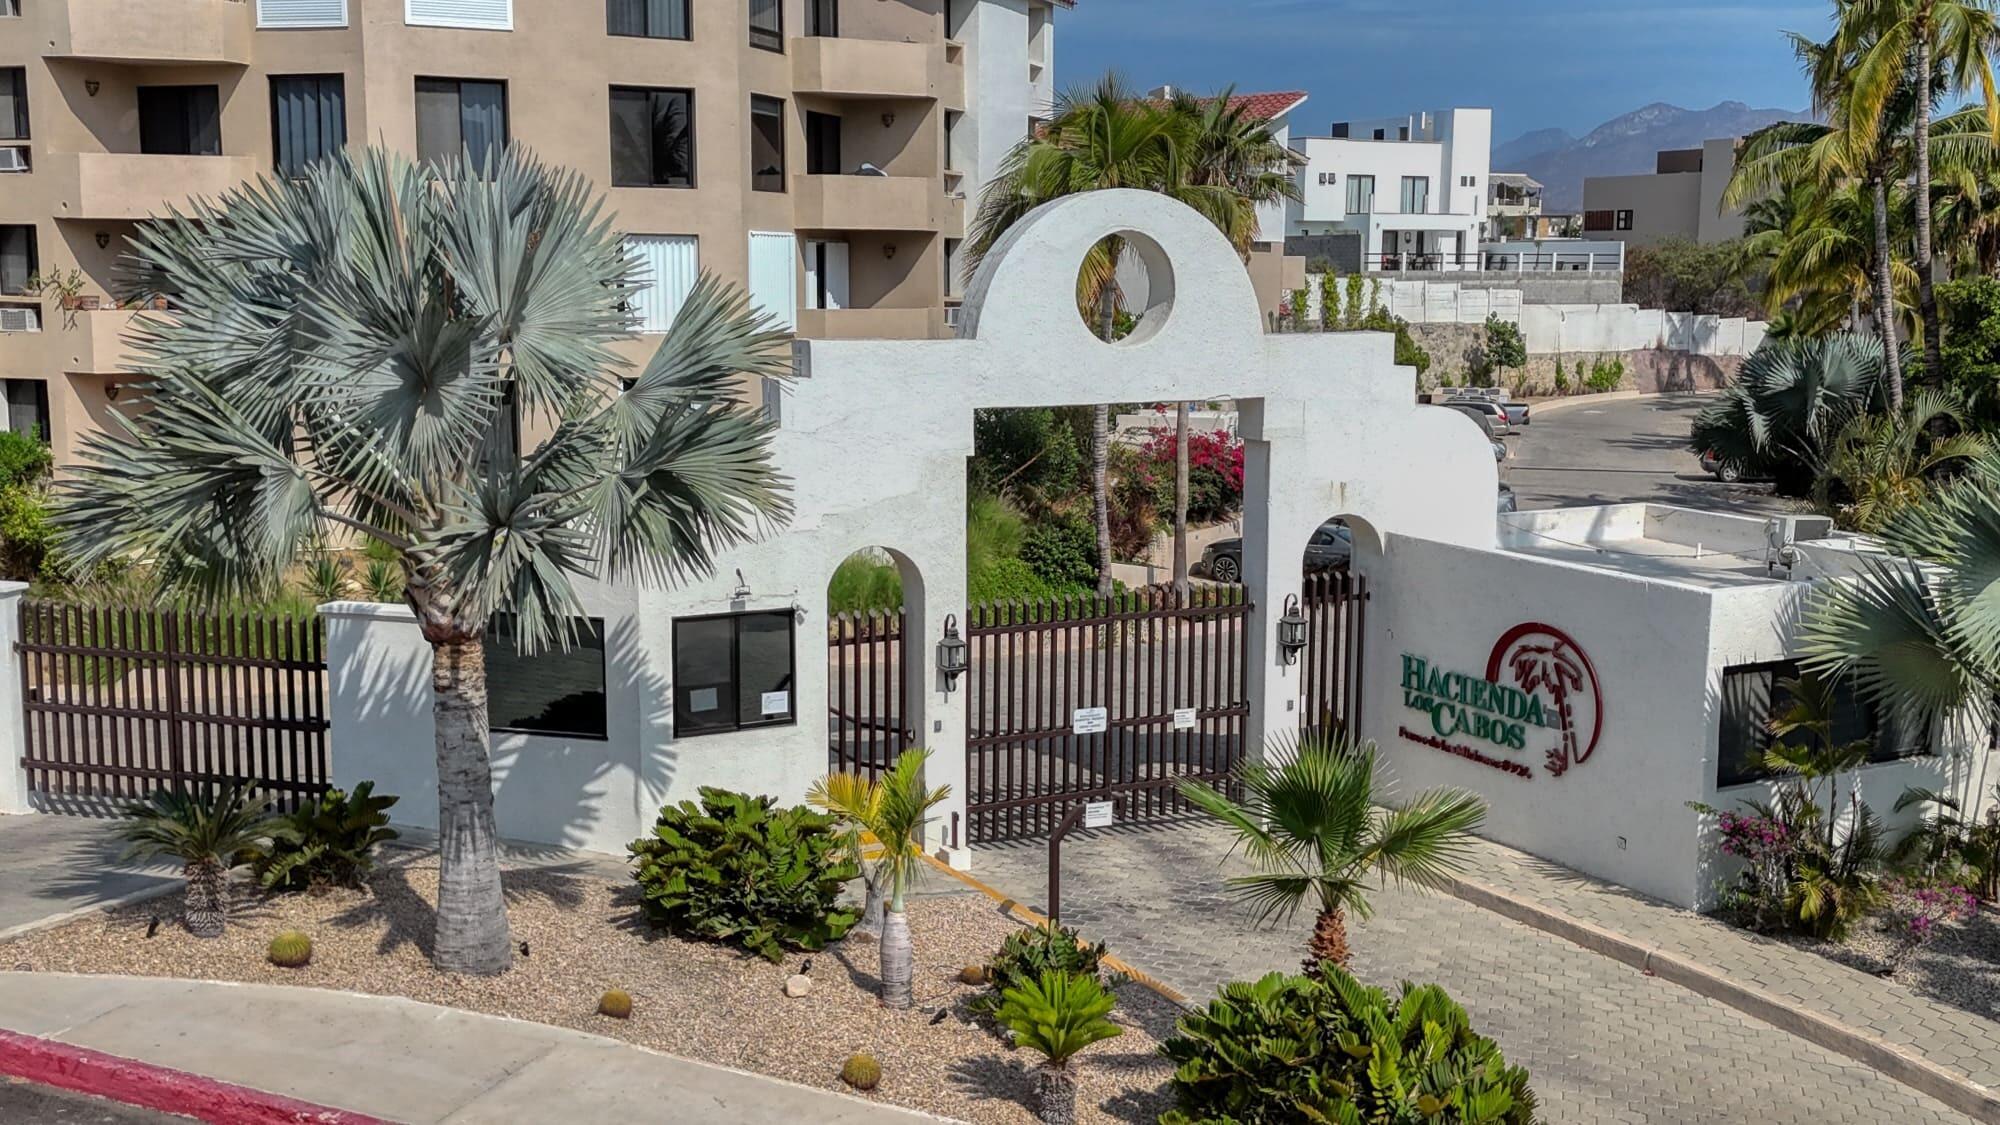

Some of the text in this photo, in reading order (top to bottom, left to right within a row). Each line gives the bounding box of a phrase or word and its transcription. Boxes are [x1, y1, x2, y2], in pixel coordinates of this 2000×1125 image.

[1400, 653, 1545, 727] HACIENDA
[1403, 690, 1526, 750] LOS CABOS
